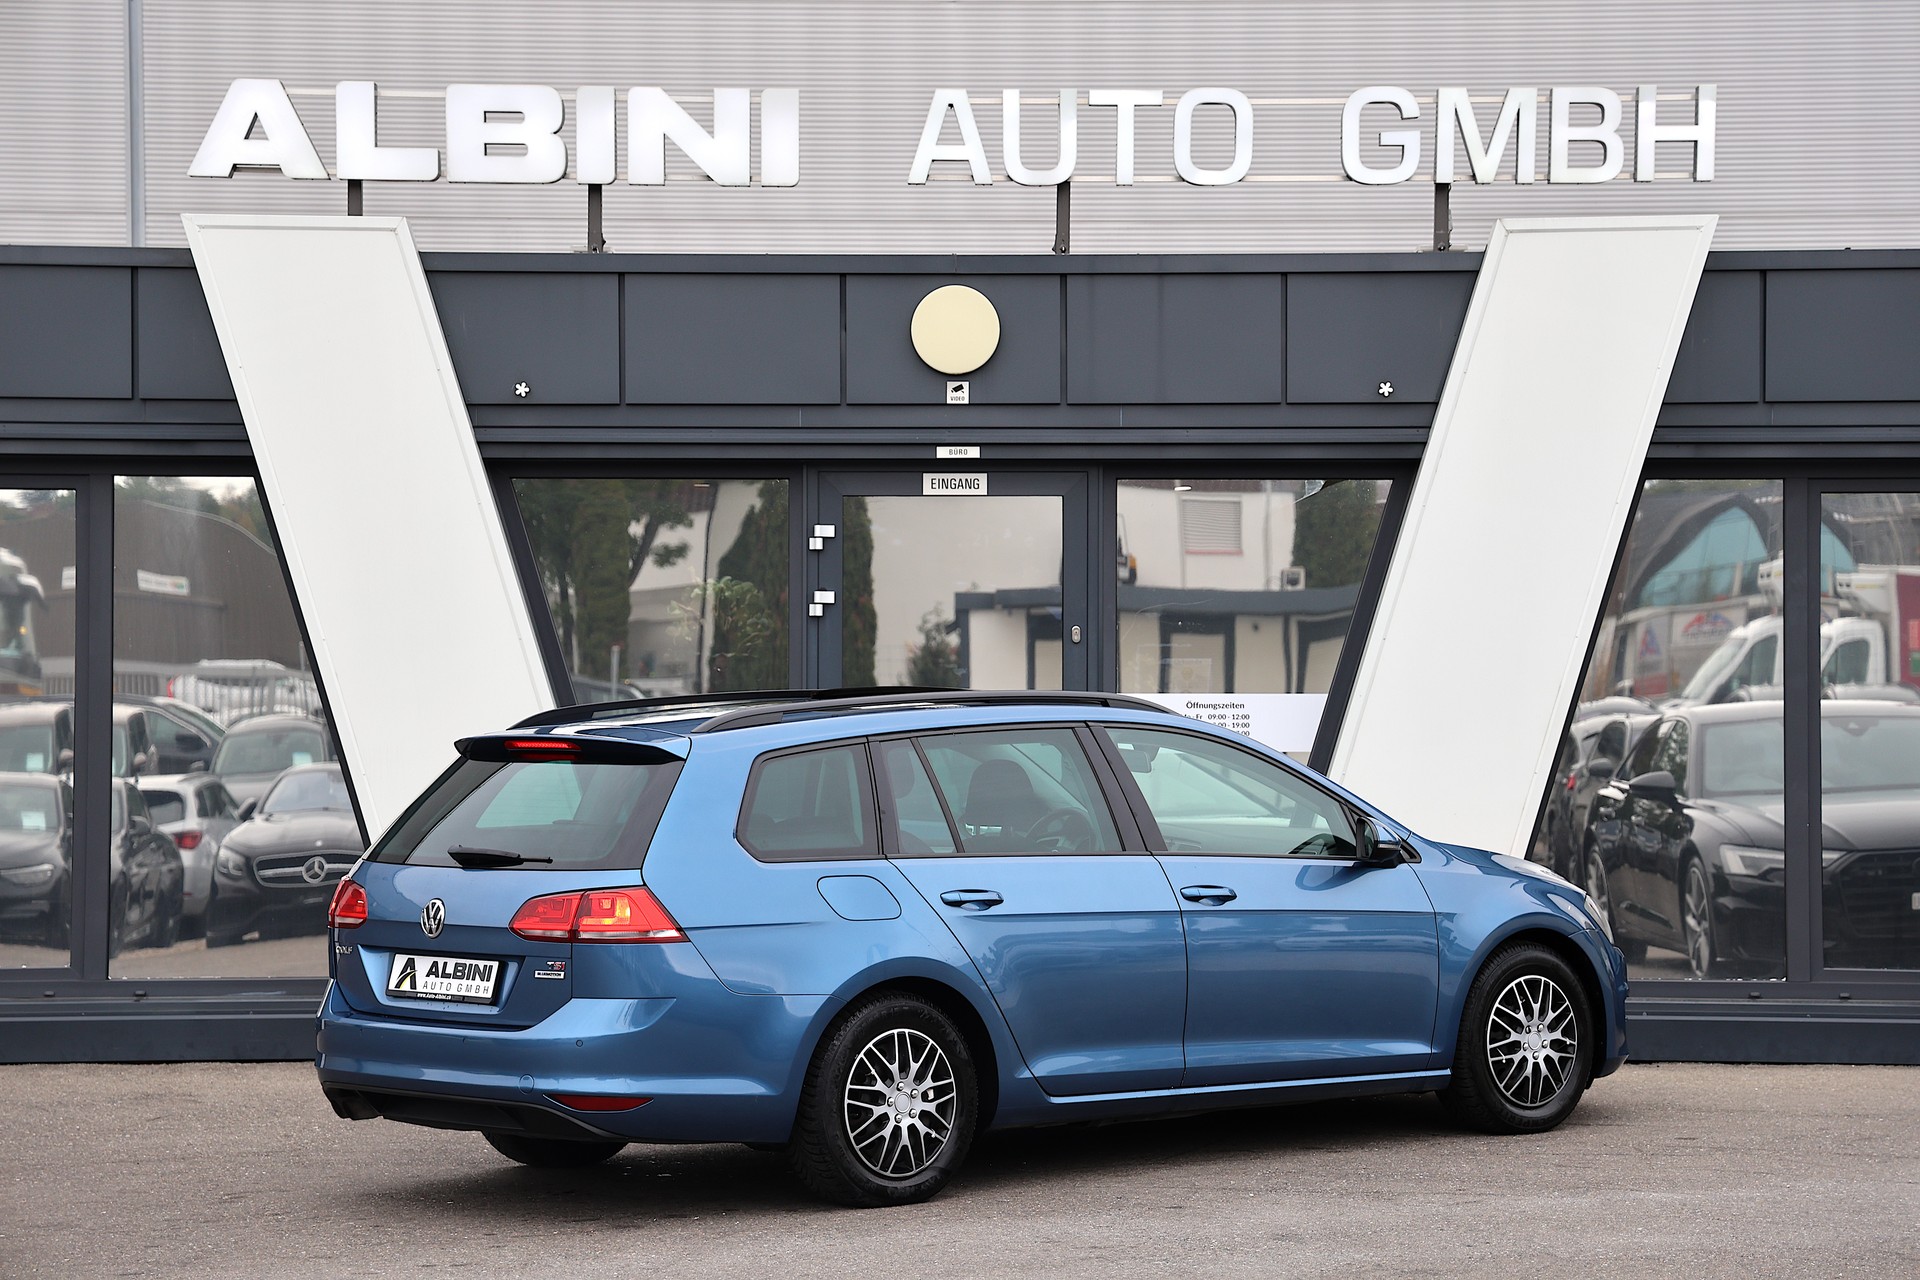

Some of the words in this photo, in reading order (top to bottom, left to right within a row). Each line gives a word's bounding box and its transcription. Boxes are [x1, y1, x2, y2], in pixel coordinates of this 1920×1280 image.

[187, 78, 800, 187] ALBINI
[907, 87, 1255, 187] AUTO
[1340, 84, 1718, 186] GMBH
[948, 447, 968, 456] BÜRO
[930, 478, 980, 490] EINGANG
[1185, 700, 1245, 710] Öffnungszeiten
[425, 960, 493, 982] ALBINI
[546, 961, 565, 970] TSI
[422, 980, 452, 992] AUTO
[457, 983, 490, 994] GMBH
